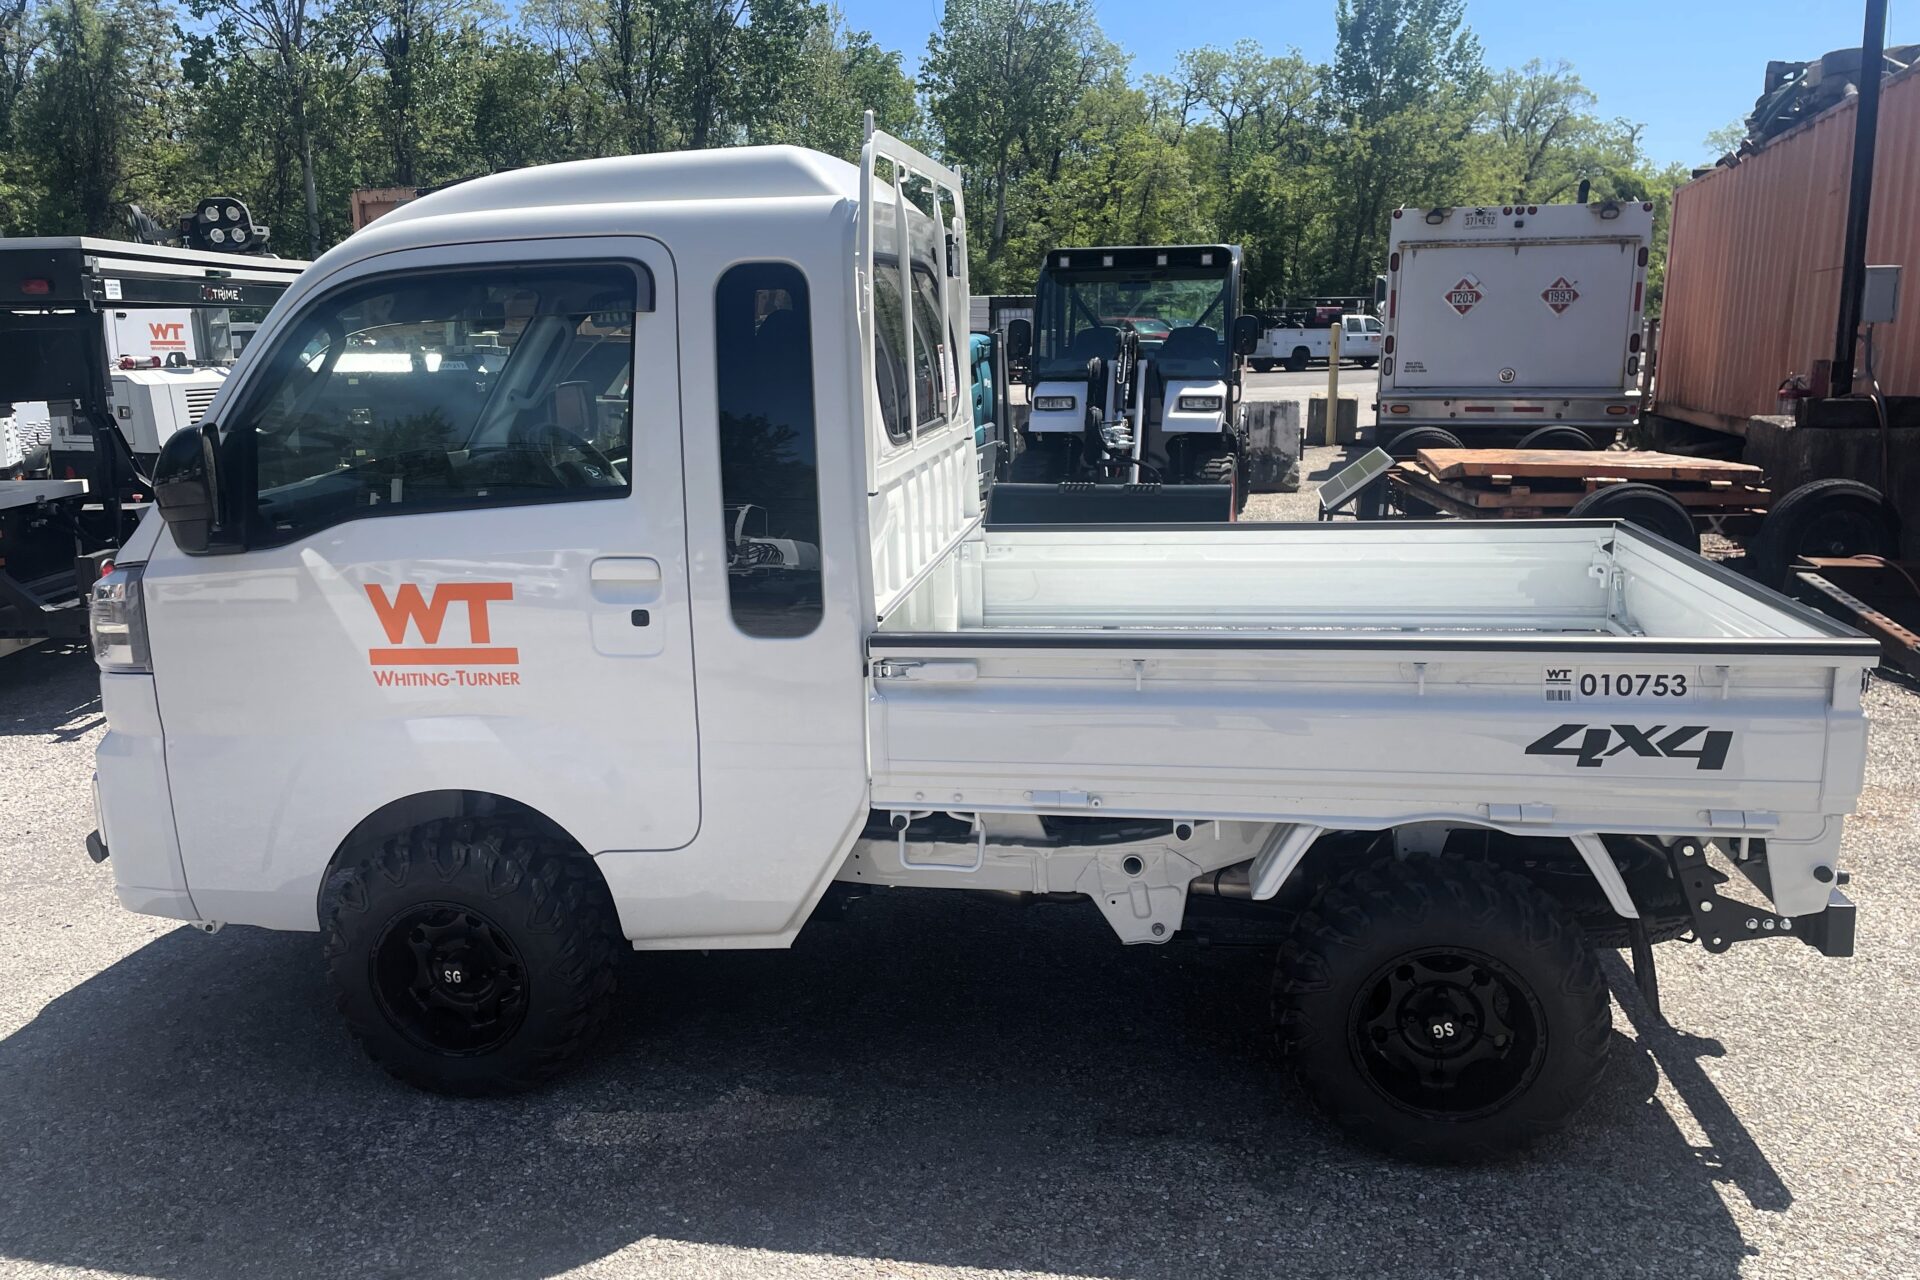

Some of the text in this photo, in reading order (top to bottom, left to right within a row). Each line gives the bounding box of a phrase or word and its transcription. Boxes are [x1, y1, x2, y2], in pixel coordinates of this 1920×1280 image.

[1453, 293, 1475, 304] 1203
[1550, 291, 1572, 302] 1993
[148, 323, 184, 340] WT
[363, 582, 514, 644] WT
[373, 670, 520, 687] WHITING-TURNER
[1547, 669, 1572, 679] WT
[1580, 673, 1688, 697] 010753
[444, 970, 462, 983] SG
